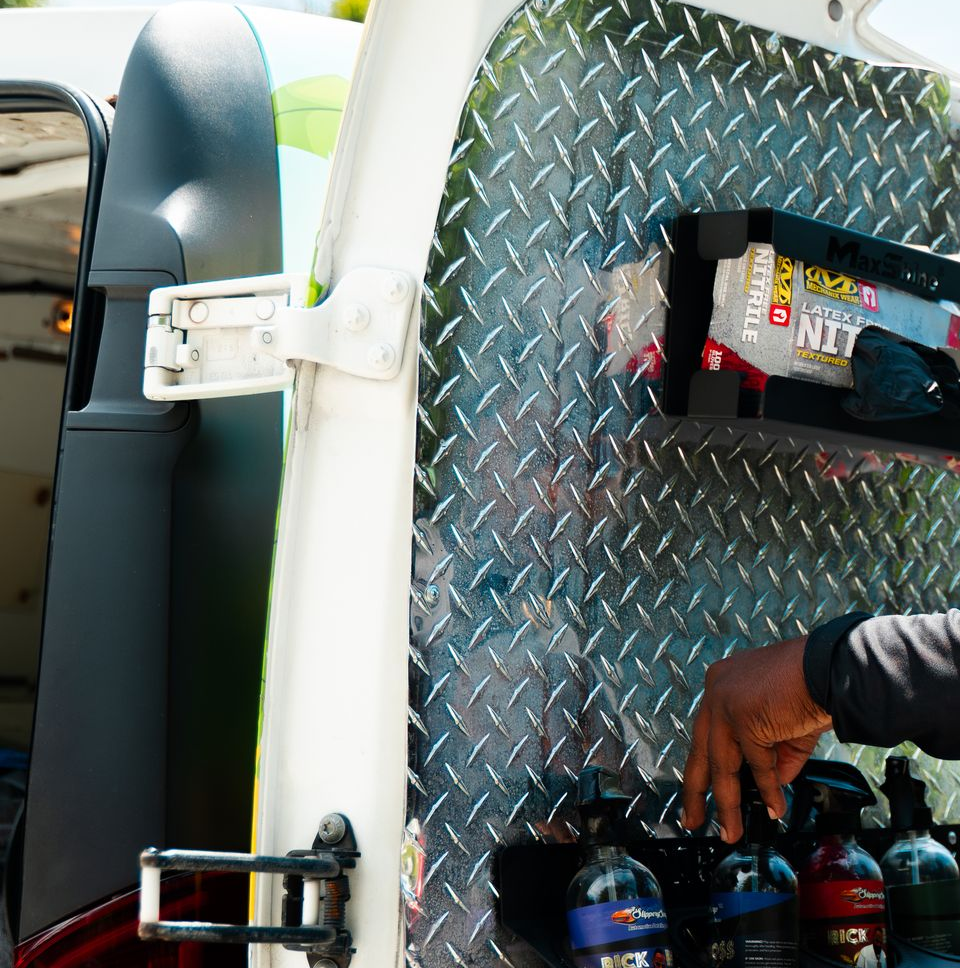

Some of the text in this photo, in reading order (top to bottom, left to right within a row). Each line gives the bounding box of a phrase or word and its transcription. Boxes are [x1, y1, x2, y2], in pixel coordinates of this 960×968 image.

[741, 248, 769, 344] NITRILE
[806, 281, 861, 305] MECHANIX WEAR
[802, 302, 856, 323] LATEX
[796, 313, 862, 358] NIT
[714, 350, 723, 371] 100
[796, 349, 849, 368] TEXTURED
[712, 937, 736, 961] OSS
